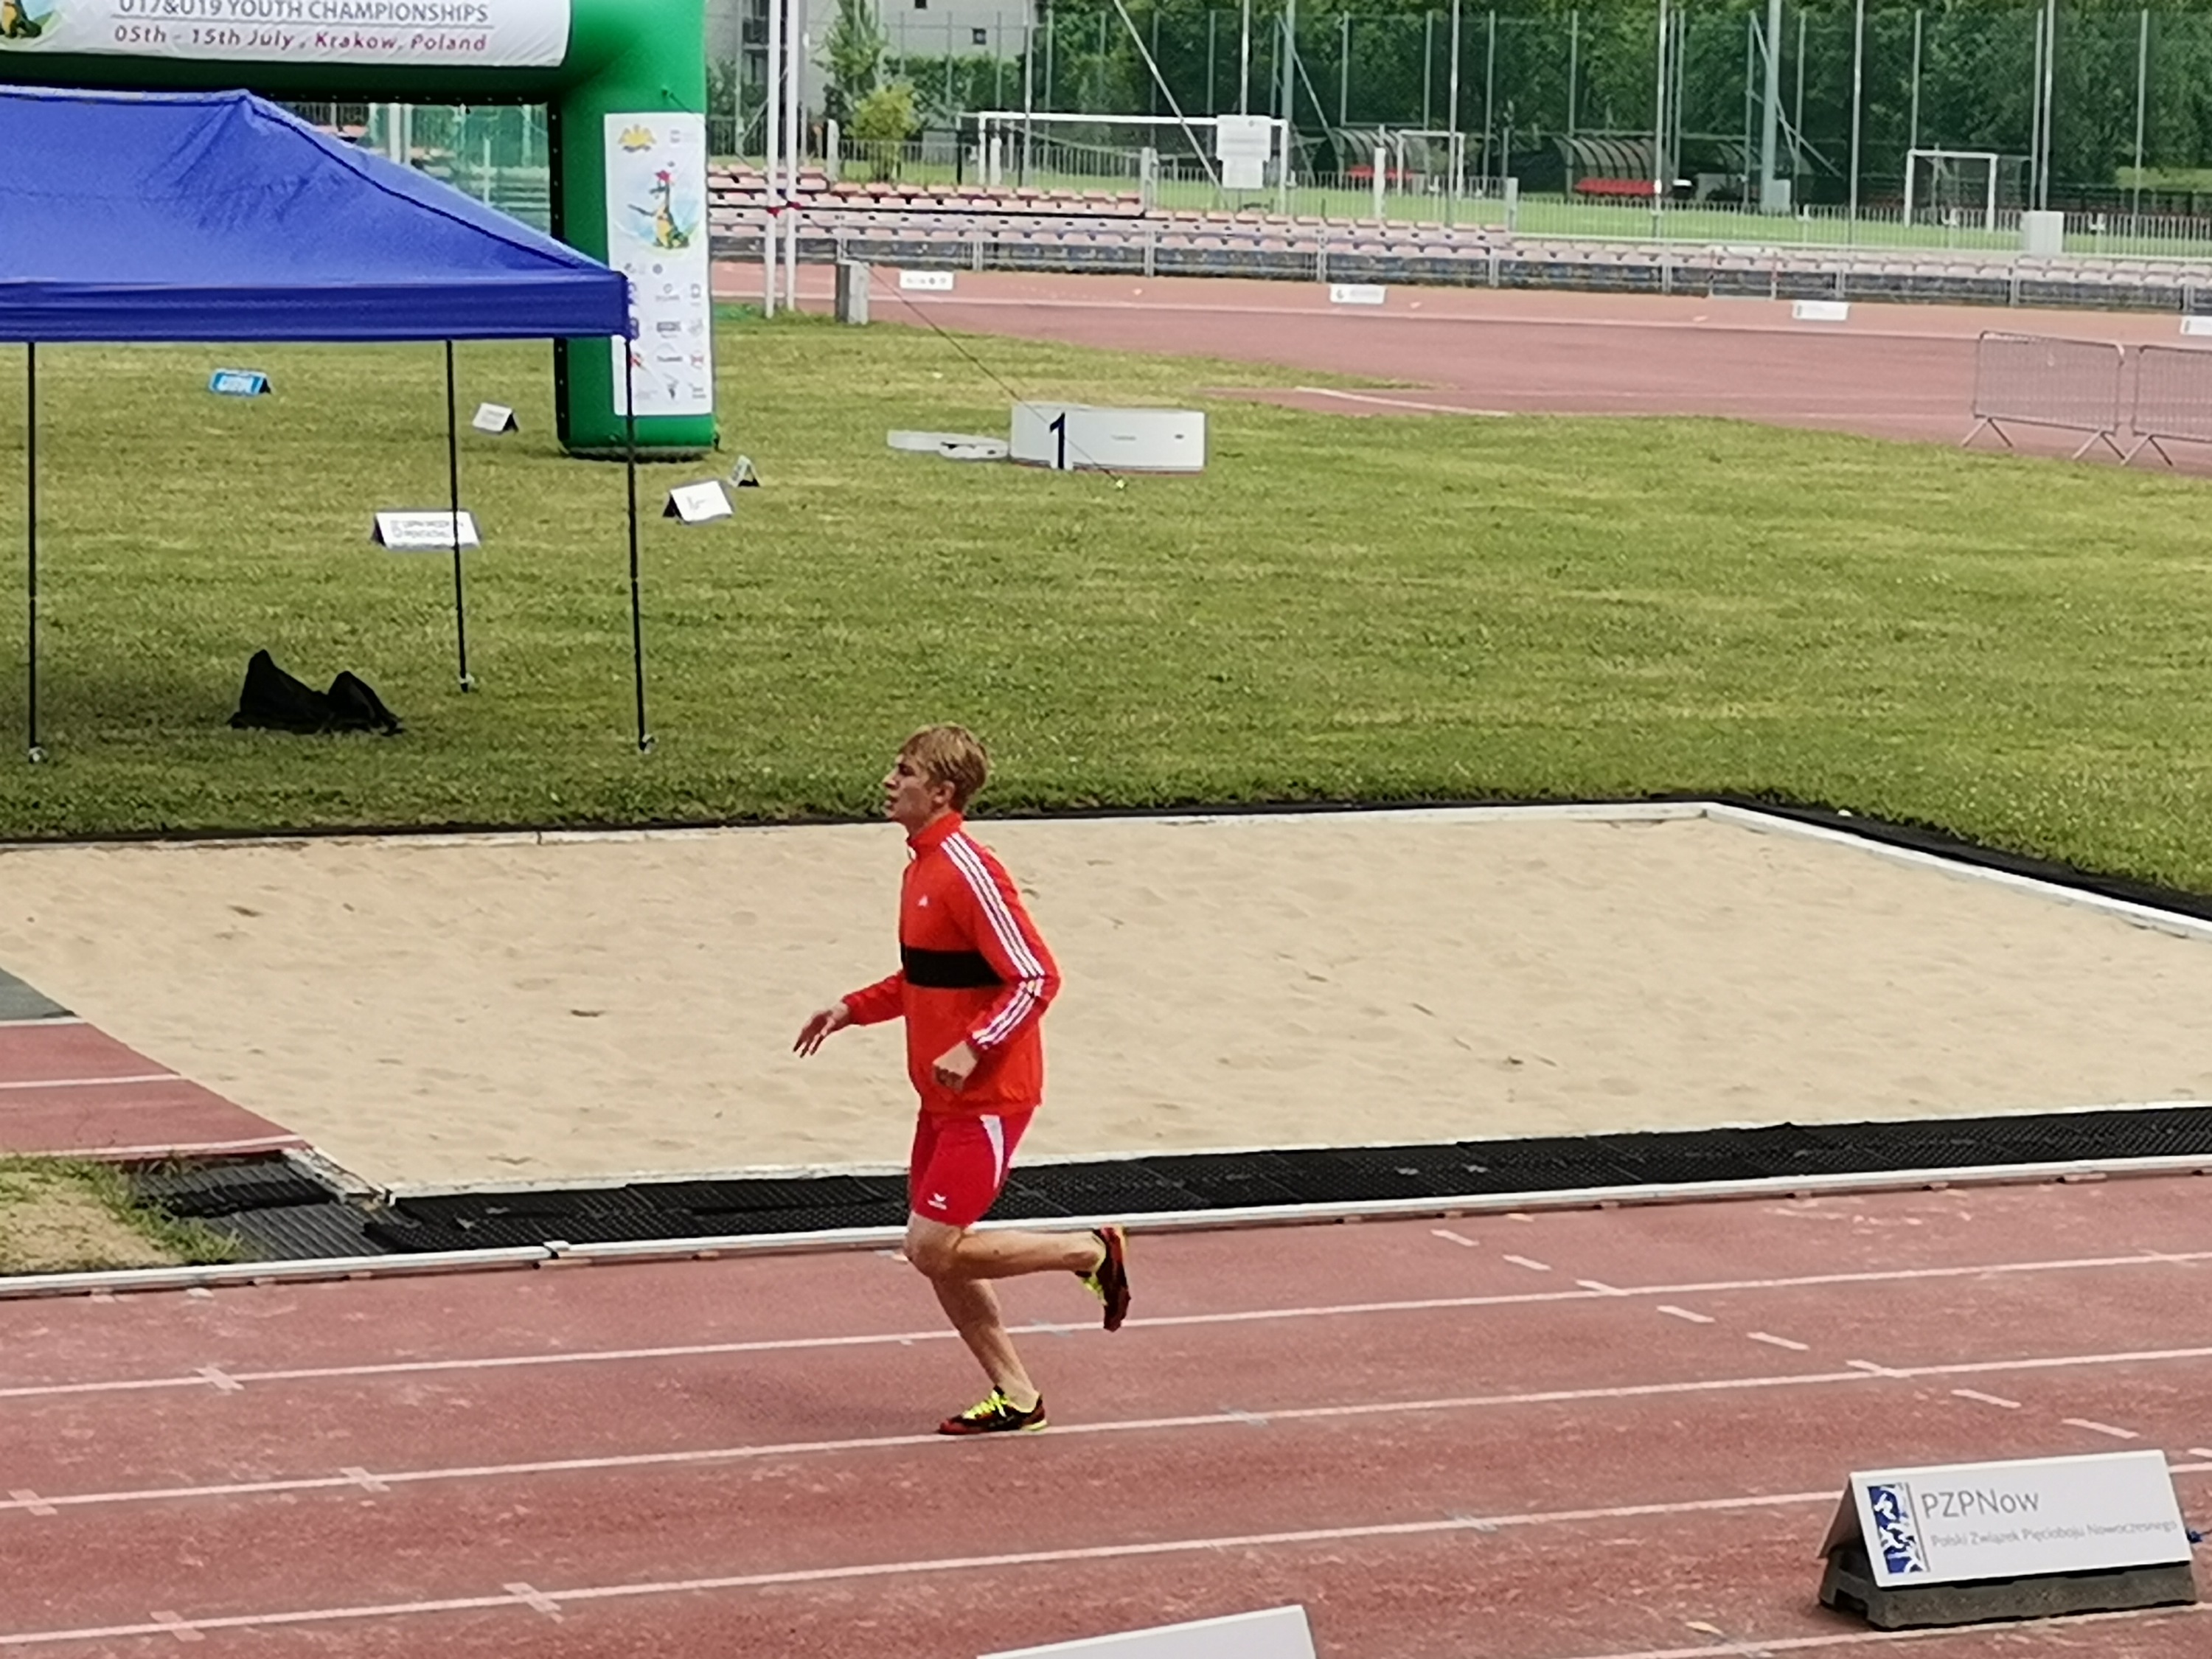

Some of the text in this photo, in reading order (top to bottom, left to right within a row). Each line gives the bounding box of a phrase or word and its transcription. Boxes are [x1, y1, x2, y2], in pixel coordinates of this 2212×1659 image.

[119, 0, 489, 22] U17&U19 YOUTH CHAMPIONSHIPS
[114, 25, 167, 43] 05th
[192, 28, 241, 45] 15th
[315, 31, 404, 51] Krakow,
[410, 33, 487, 51] Poland
[1050, 411, 1066, 470] 1
[1921, 1488, 2039, 1519] PZPNow
[1930, 1532, 1968, 1547] Polski
[2086, 1521, 2177, 1537] Nowoczesnego
